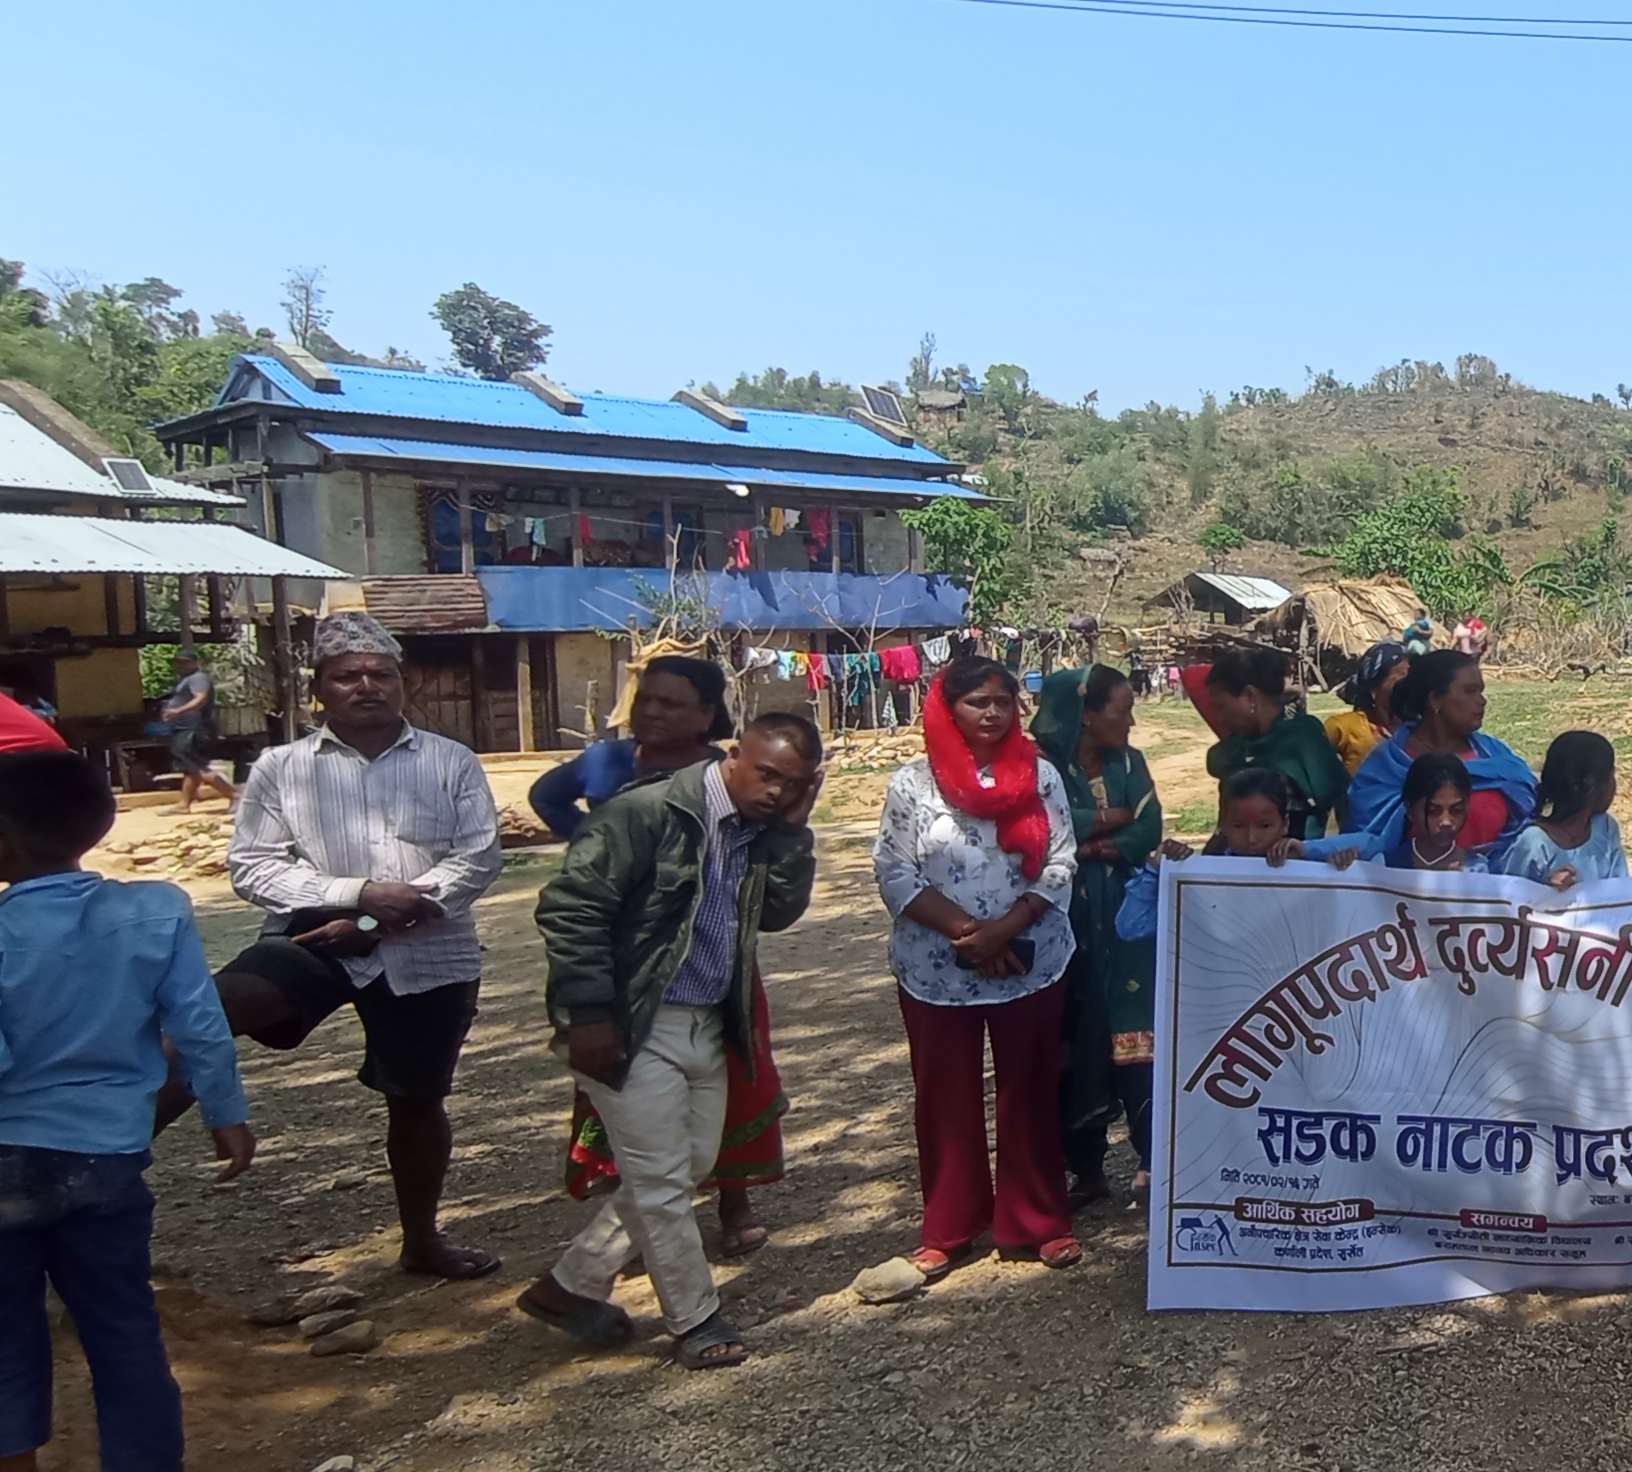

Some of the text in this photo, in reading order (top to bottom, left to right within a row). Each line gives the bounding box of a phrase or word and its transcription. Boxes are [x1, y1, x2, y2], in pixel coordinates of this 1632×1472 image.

[1183, 902, 1428, 1109] लागूपदार्थ
[1257, 1106, 1381, 1167] सडक
[1396, 1114, 1538, 1175] नाटक
[1242, 1201, 1360, 1225] आर्थिक सहयोग
